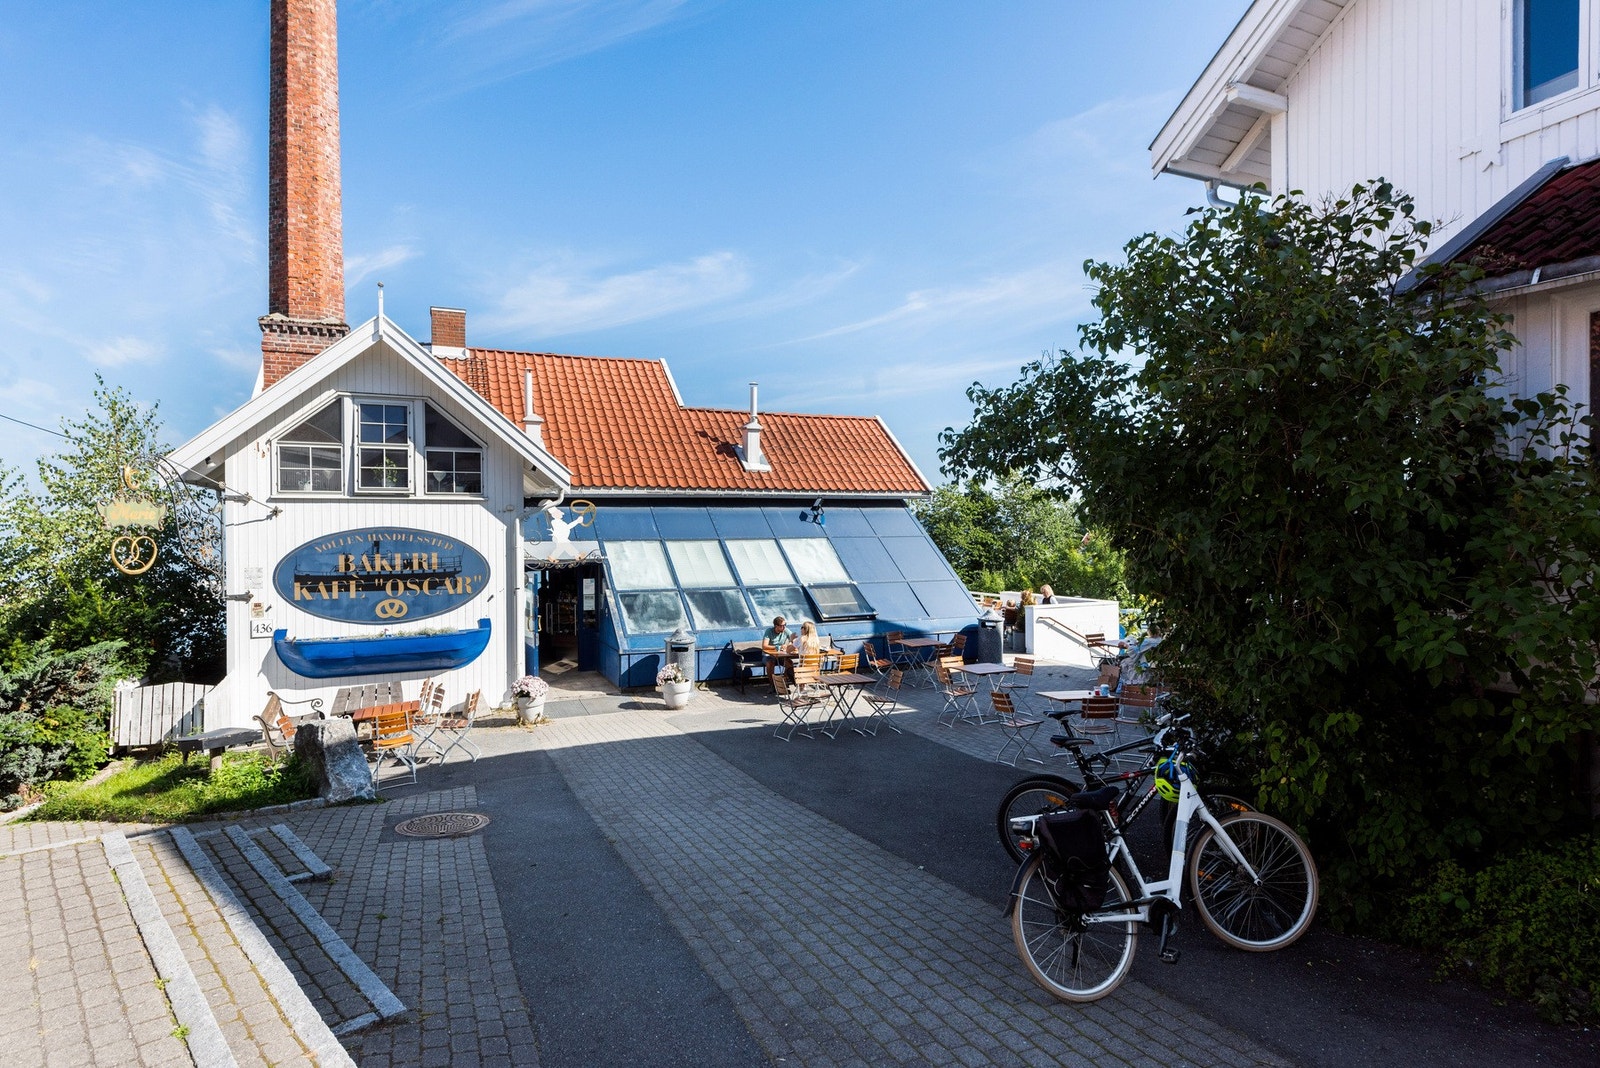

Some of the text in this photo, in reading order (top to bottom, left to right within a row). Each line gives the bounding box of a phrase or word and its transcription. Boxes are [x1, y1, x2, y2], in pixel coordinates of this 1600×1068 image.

[367, 533, 454, 551] HANDELSSTED
[338, 552, 438, 572] BAKERI
[375, 575, 482, 598] "OSCAR"
[252, 623, 273, 634] 436
[1125, 784, 1157, 824] SCHWIN
